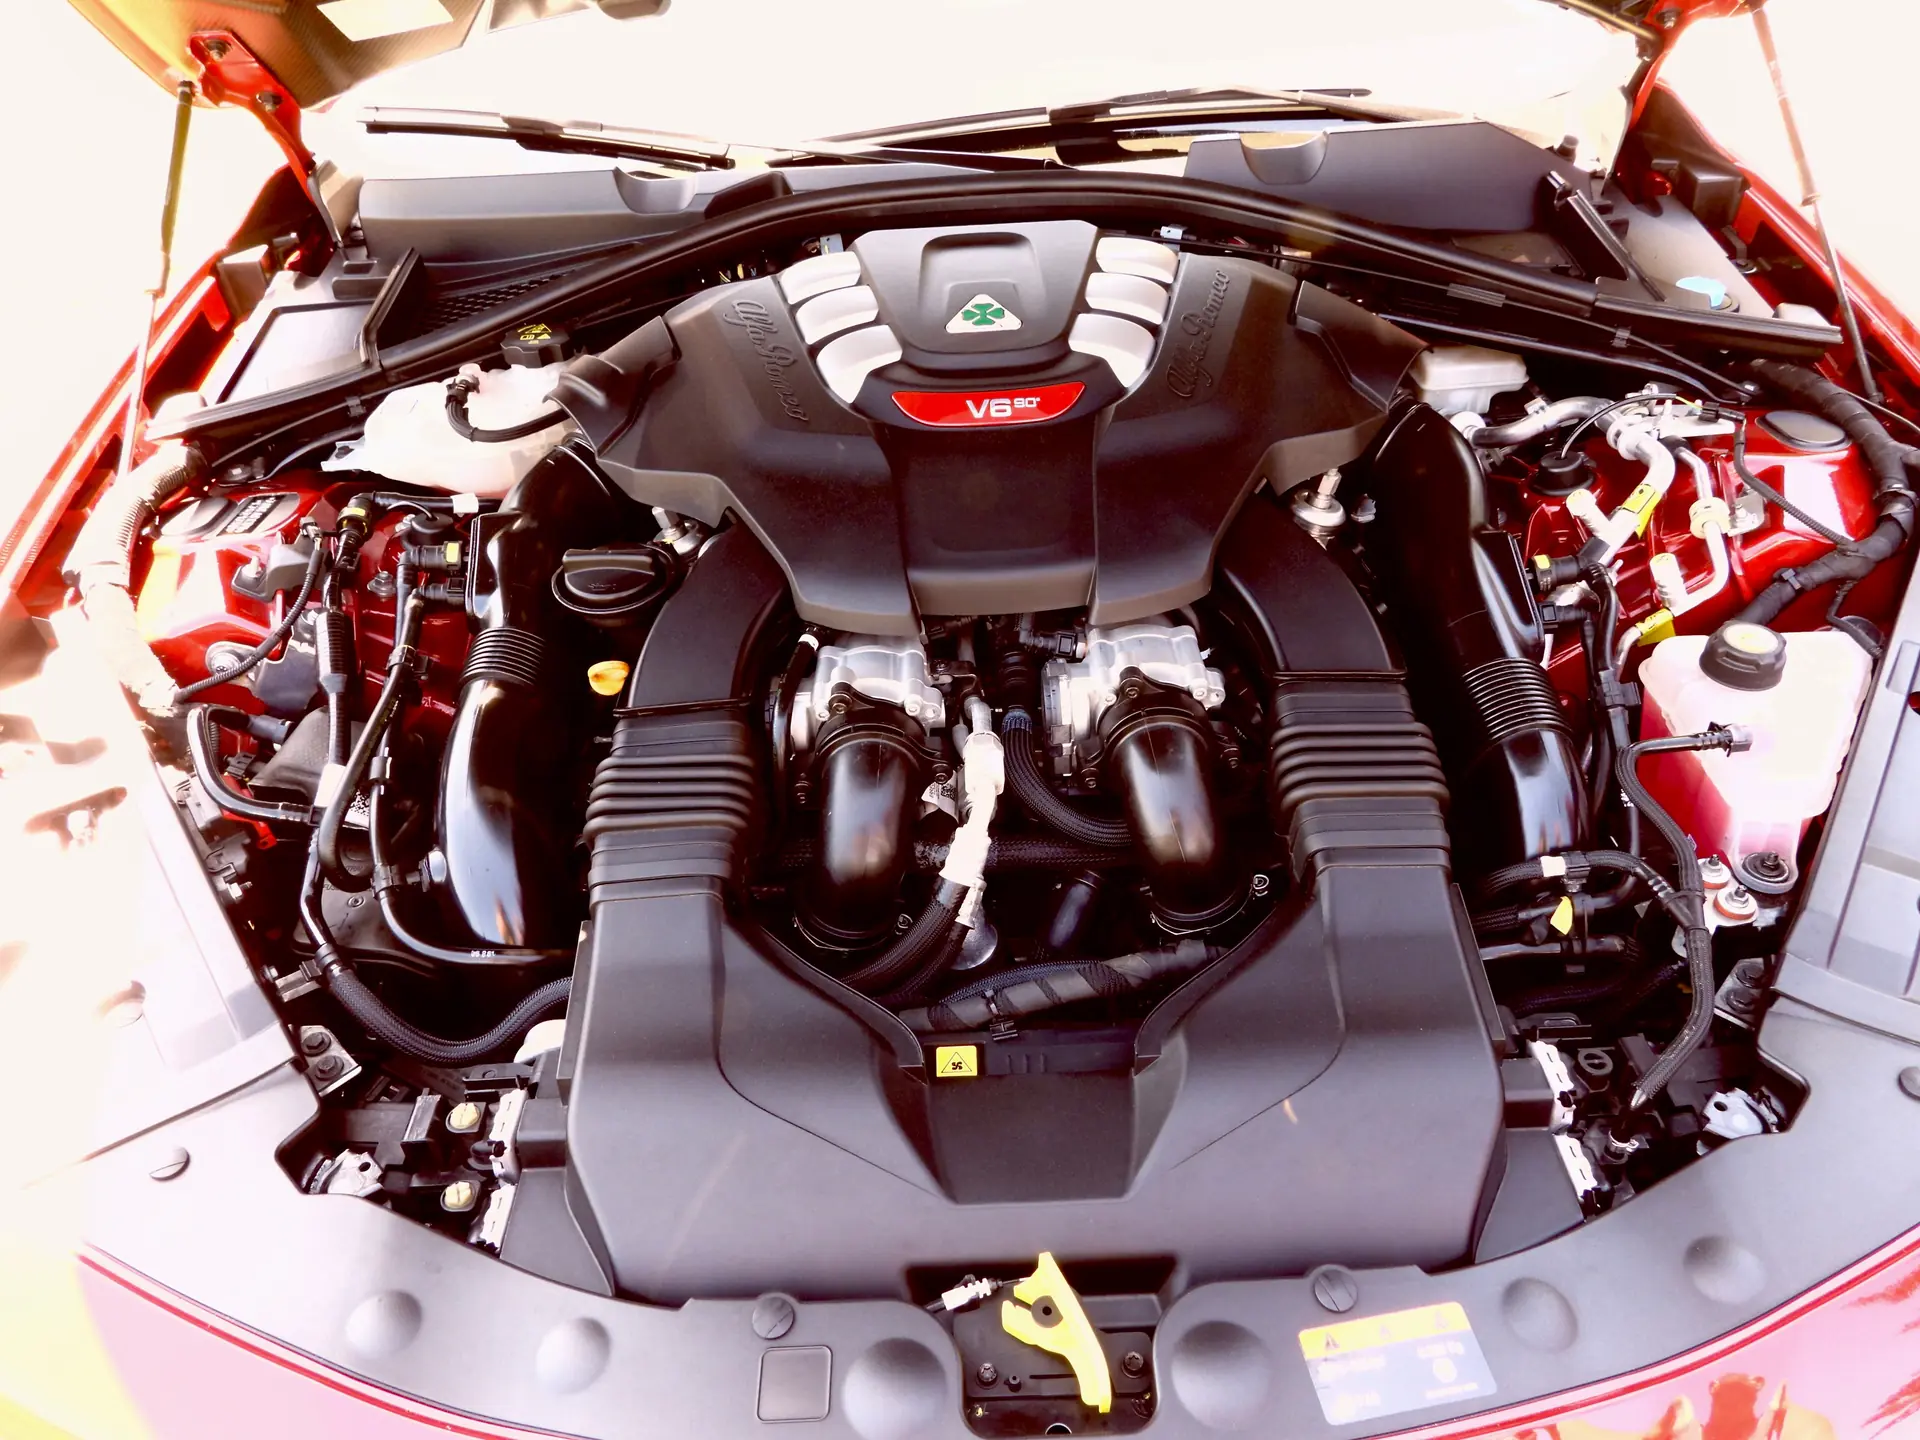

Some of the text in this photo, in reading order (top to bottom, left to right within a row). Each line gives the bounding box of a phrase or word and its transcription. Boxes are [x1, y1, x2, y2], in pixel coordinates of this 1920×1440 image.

[1181, 269, 1231, 341] Romeo
[723, 299, 809, 421] Alfa Romeo
[966, 399, 1012, 418] V6
